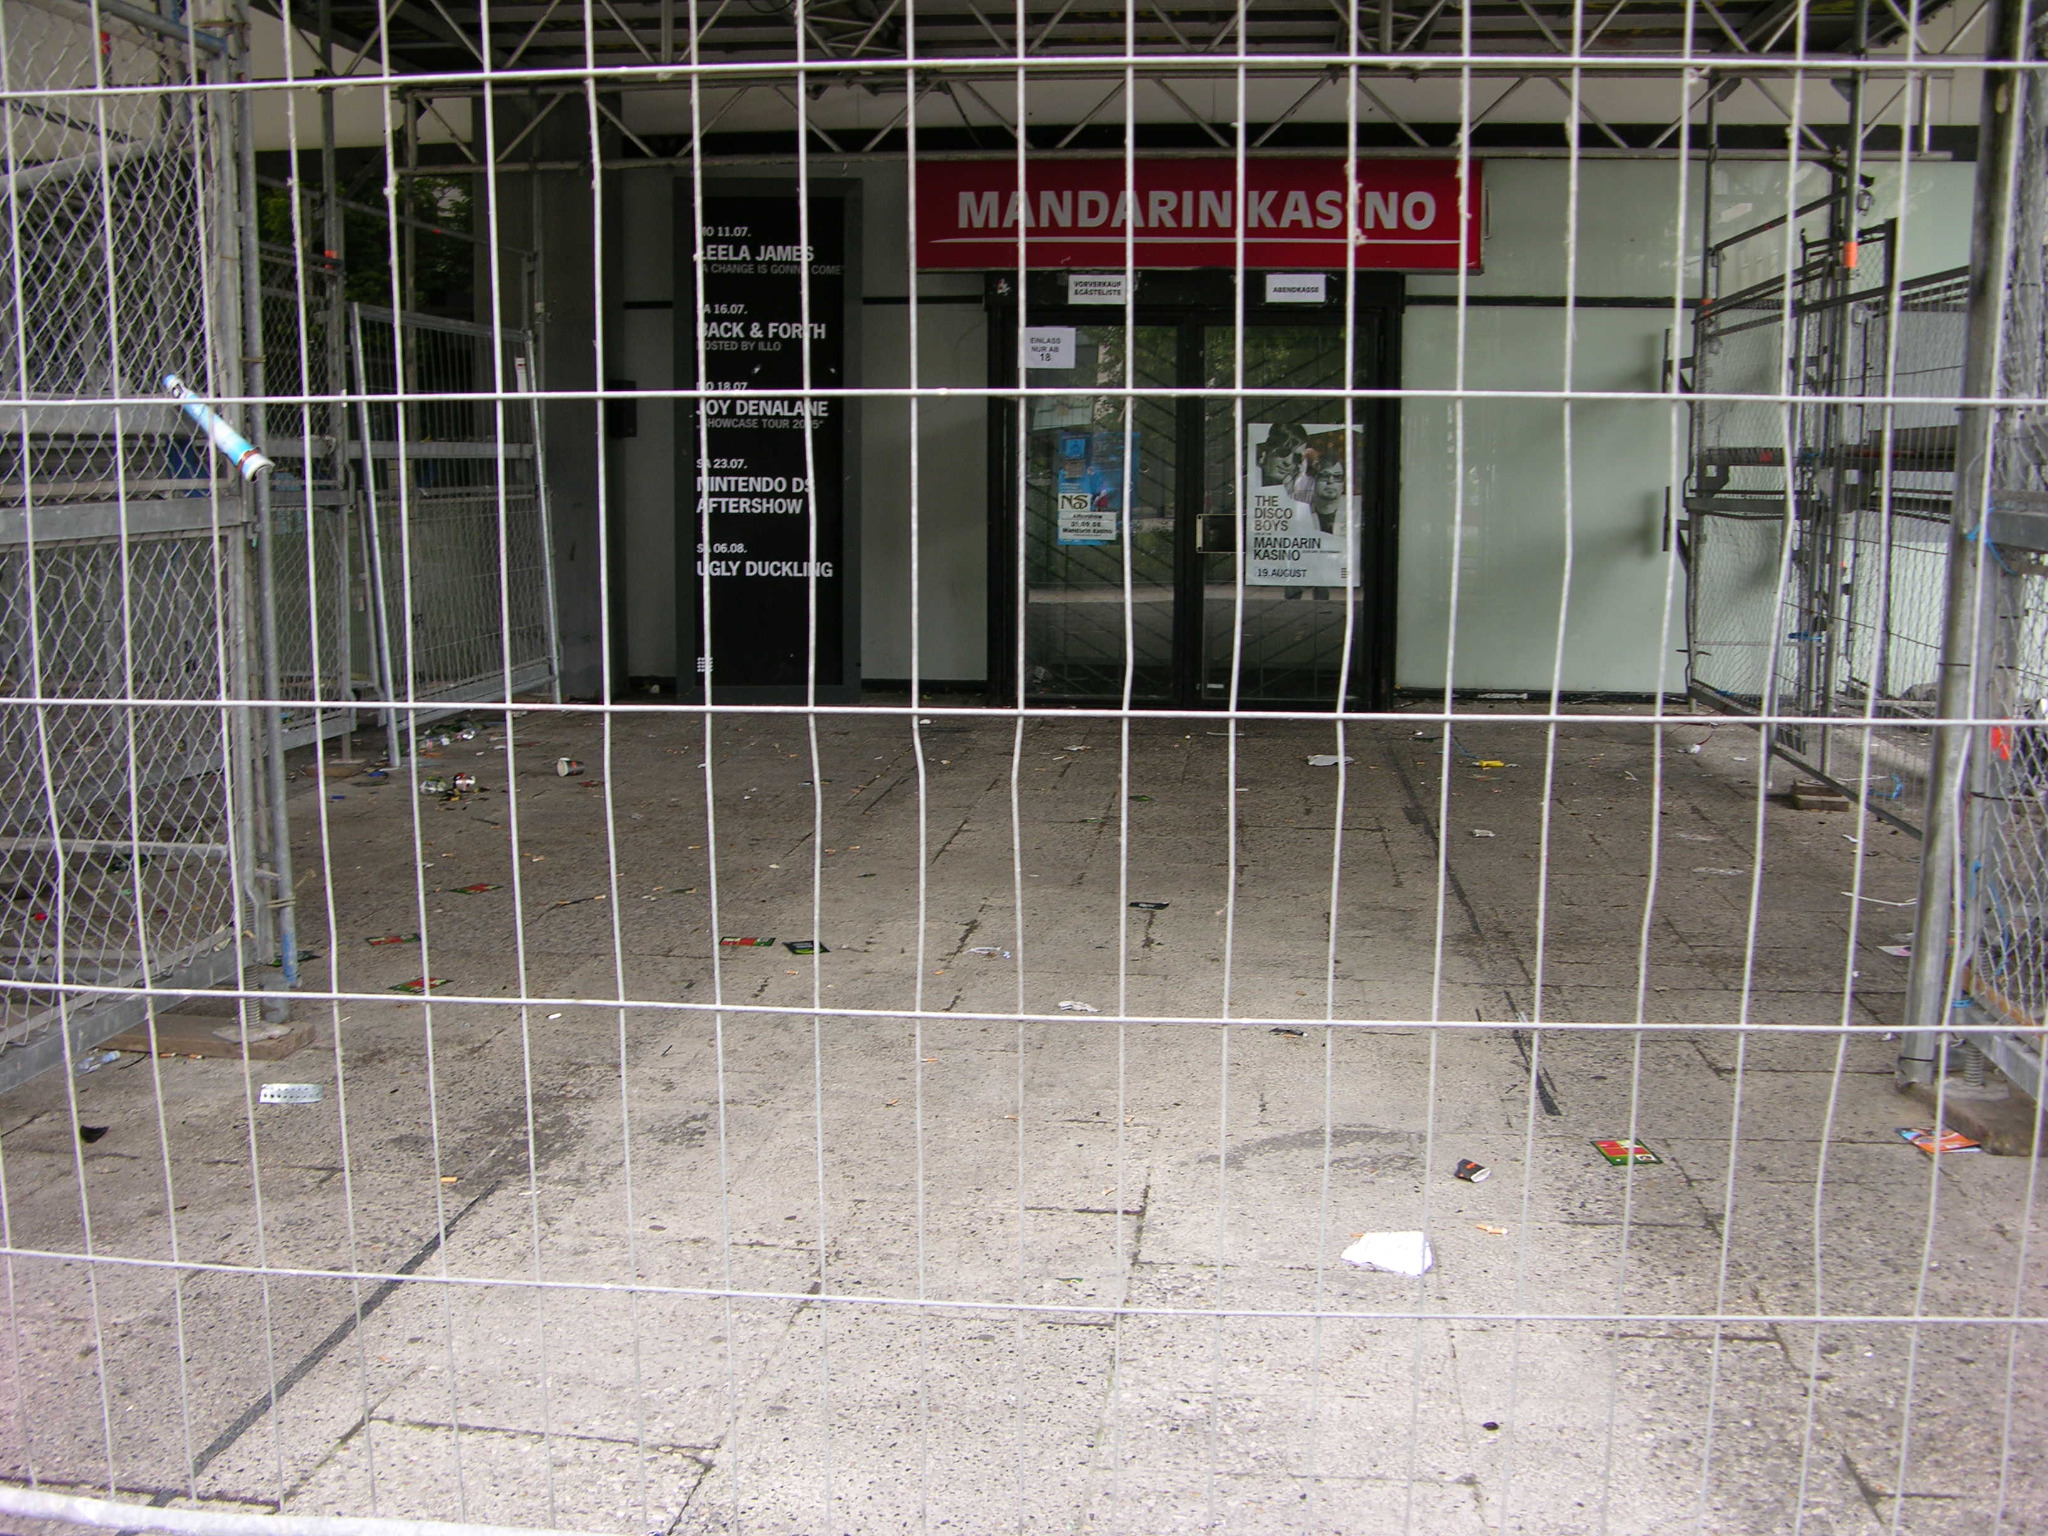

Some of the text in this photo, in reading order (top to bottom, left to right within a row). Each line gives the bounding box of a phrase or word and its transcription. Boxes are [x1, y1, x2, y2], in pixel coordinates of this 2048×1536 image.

[958, 190, 1436, 230] MANDARIN KASNO
[717, 226, 752, 237] 11.07.
[697, 245, 815, 262] EELA JAMES
[710, 264, 755, 274] CHANGE
[757, 264, 768, 274] IS
[770, 264, 808, 275] GONN
[713, 304, 748, 314] 16.07.
[749, 322, 764, 338] &
[697, 341, 739, 351] OSTED
[741, 341, 756, 351] BY
[1040, 353, 1051, 362] 18
[735, 399, 829, 417] DENALANE
[762, 418, 789, 429] TOUR
[713, 458, 748, 469] 23.07.
[696, 476, 787, 493] NINTENDO
[696, 498, 803, 514] AFTERSHOW
[1254, 495, 1279, 507] THE
[1254, 508, 1293, 519] DISCO
[1254, 520, 1288, 531] BOYS
[696, 543, 748, 553] S 06.08.
[1253, 537, 1321, 549] MANDARIN
[1253, 549, 1300, 561] KASINO
[696, 560, 741, 577] UGLY
